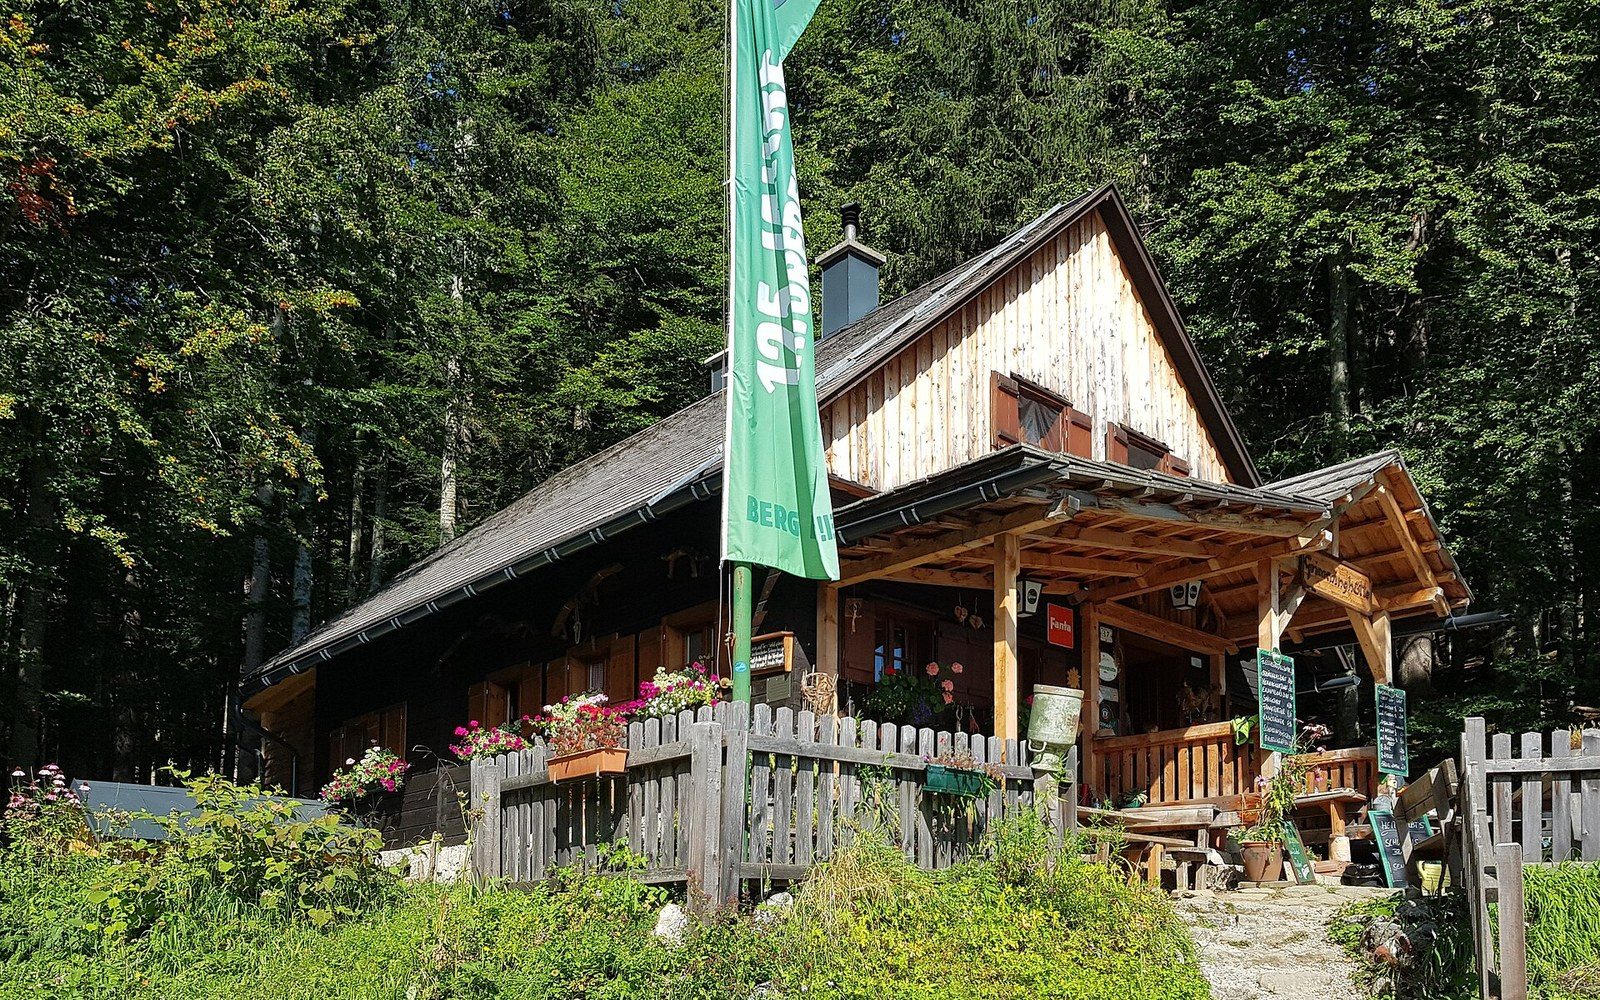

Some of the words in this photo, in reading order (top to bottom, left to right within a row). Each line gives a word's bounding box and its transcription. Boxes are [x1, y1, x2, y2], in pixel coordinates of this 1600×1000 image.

[756, 280, 799, 394] 125
[746, 495, 800, 537] BERG
[1050, 616, 1071, 632] Fanta
